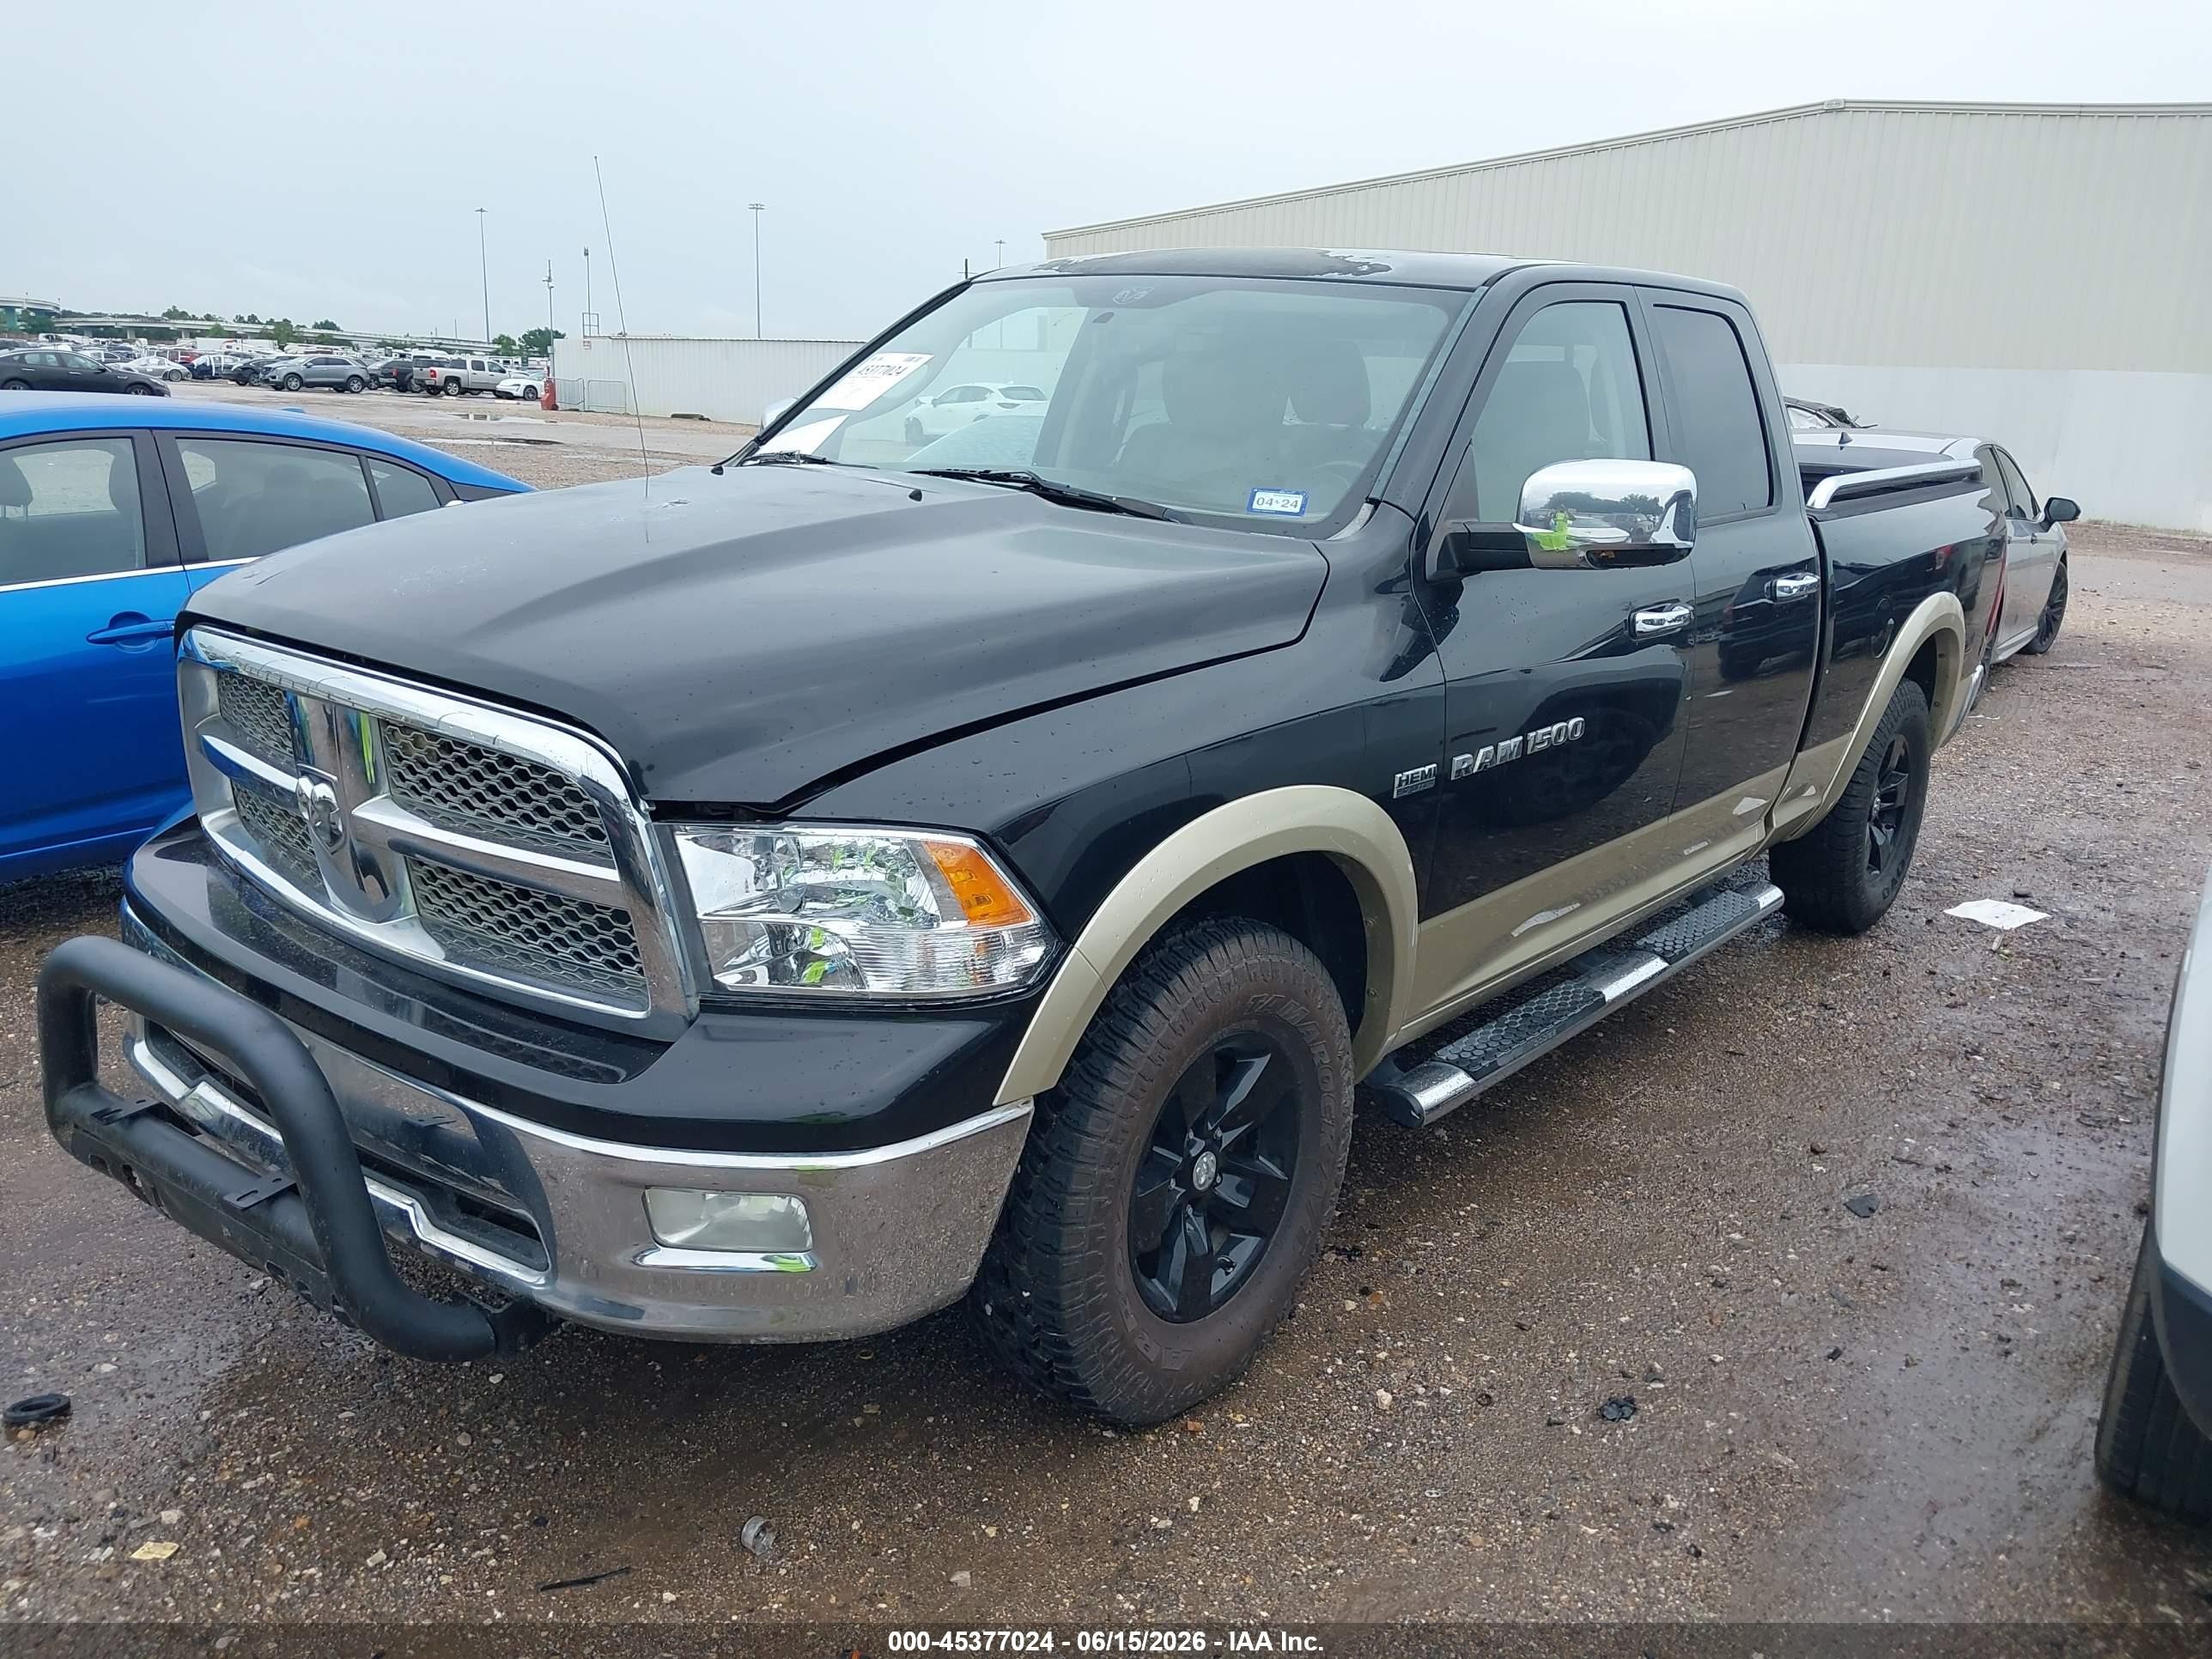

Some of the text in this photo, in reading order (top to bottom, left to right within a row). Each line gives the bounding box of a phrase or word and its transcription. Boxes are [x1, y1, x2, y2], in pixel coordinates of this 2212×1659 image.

[1450, 716, 1587, 781] RAM 1500
[1395, 763, 1437, 788] HEMI
